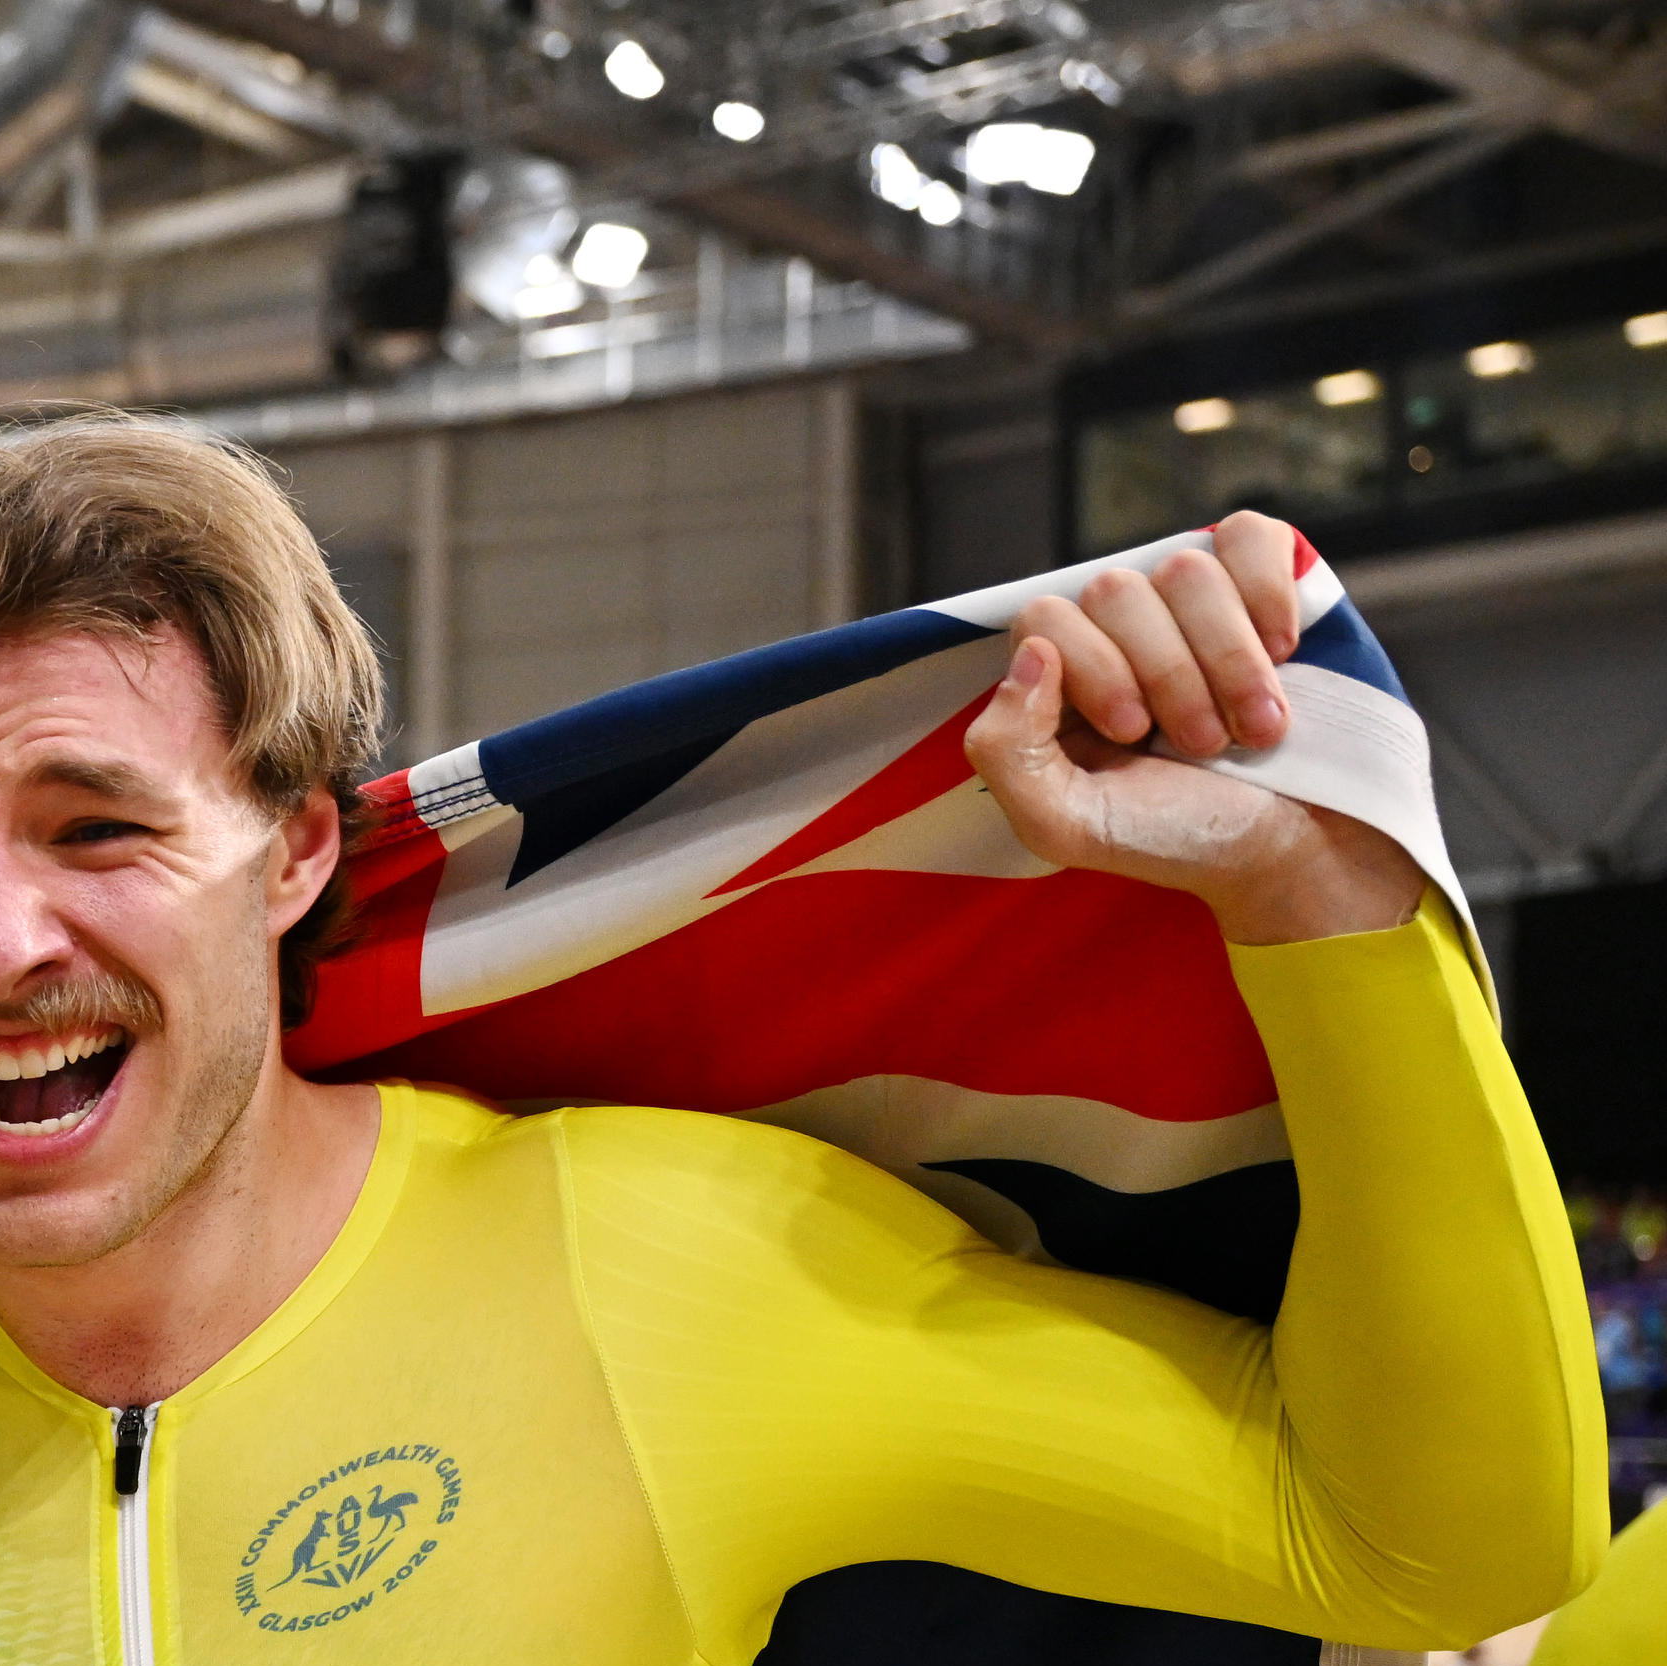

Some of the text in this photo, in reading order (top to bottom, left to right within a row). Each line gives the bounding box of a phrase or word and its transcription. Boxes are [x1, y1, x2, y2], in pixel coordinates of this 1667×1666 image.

[241, 1444, 440, 1567] COMMONWEALTH
[435, 1457, 462, 1525] GAMES
[258, 1539, 438, 1632] GLASGOW 2026
